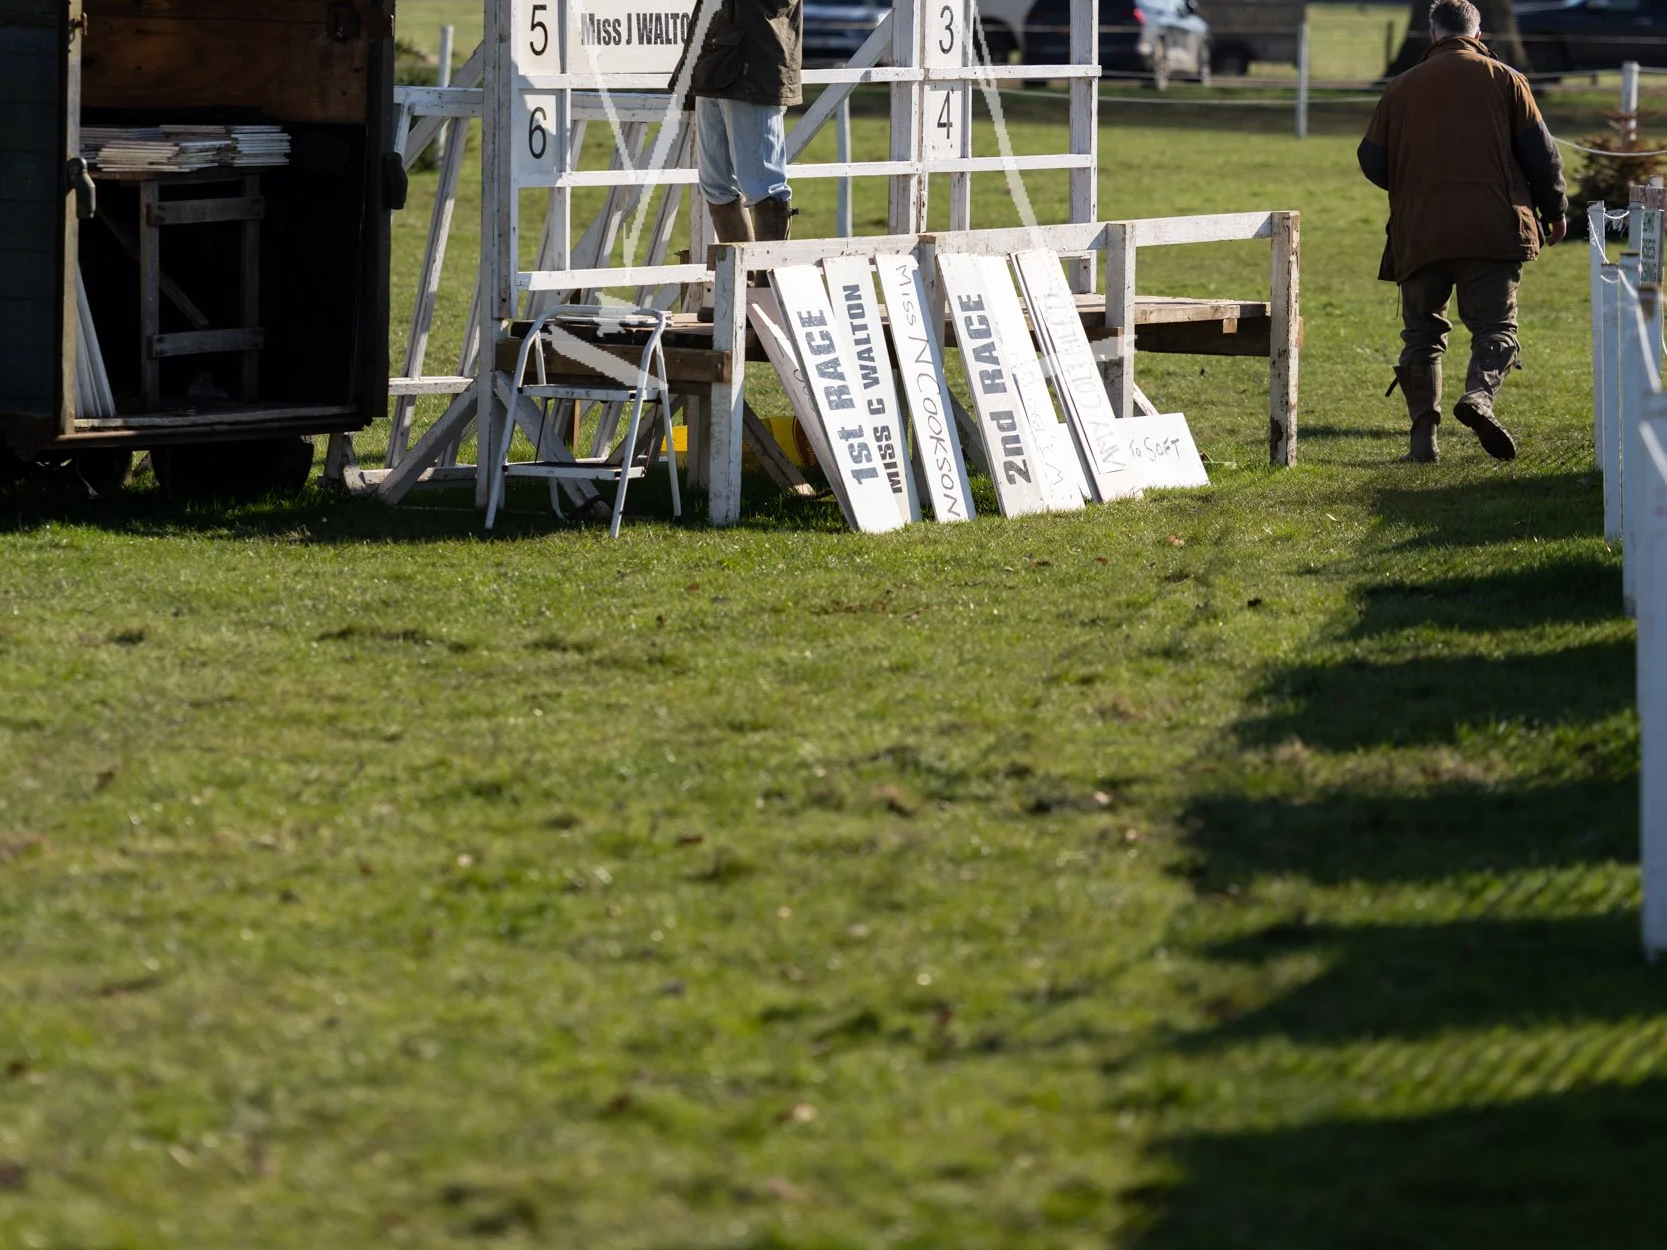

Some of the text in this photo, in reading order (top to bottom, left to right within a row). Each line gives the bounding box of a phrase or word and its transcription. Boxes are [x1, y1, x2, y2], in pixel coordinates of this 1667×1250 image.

[529, 4, 548, 56] 5
[625, 13, 633, 45] J
[938, 5, 954, 54] 3
[528, 106, 547, 159] 6
[937, 90, 953, 140] 4
[797, 309, 856, 411] RACE
[957, 294, 1008, 395] RACE
[842, 284, 902, 493] MISS C WALTON
[836, 425, 879, 485] 1st
[1001, 409, 1033, 486] 2nd
